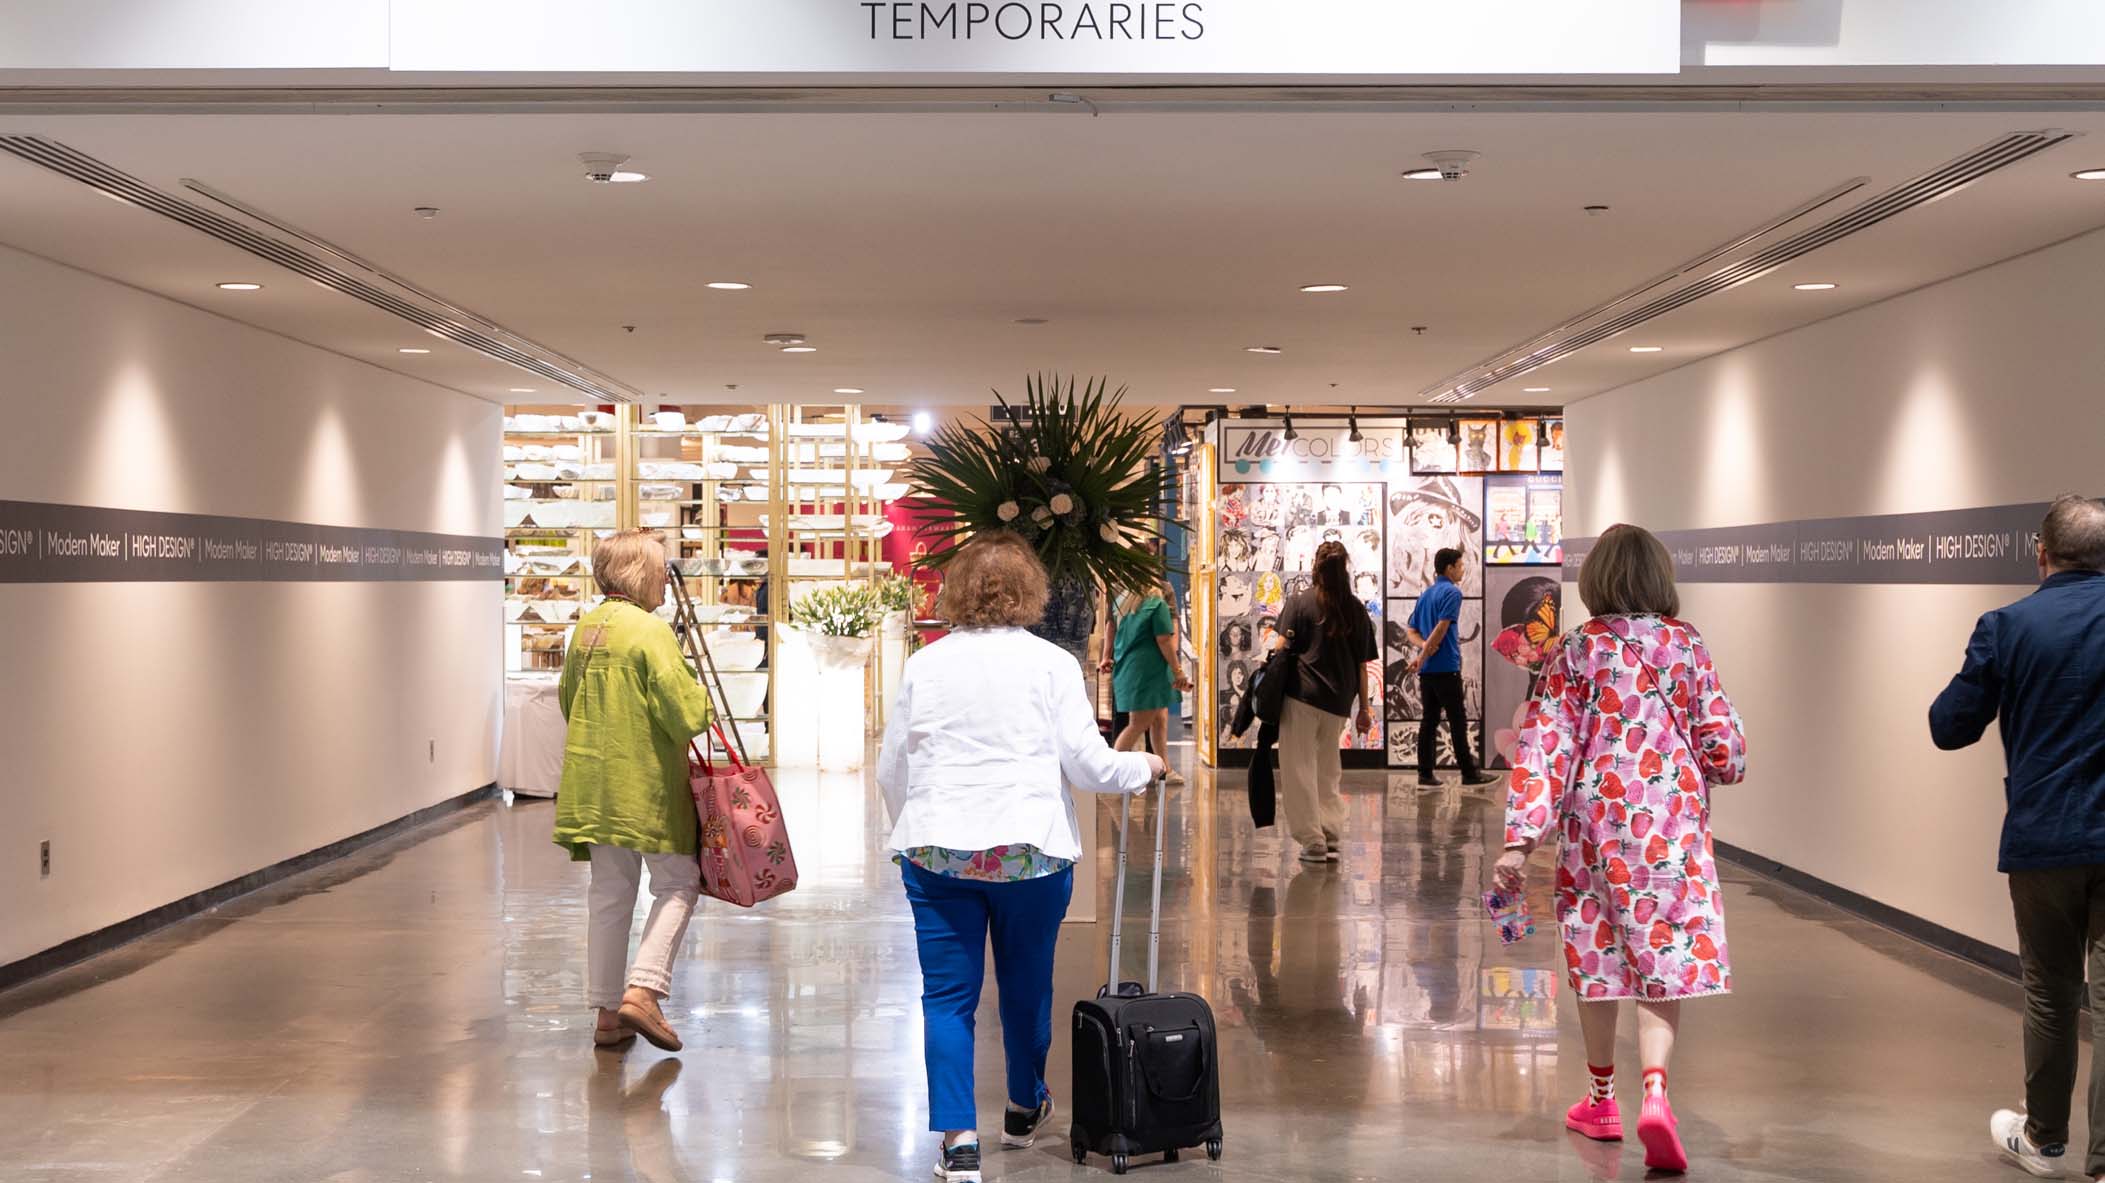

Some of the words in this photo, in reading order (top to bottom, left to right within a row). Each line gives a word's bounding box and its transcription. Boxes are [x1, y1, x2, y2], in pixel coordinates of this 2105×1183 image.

[860, 2, 1205, 40] TEMPORARIES
[48, 530, 88, 556] Modern
[89, 532, 121, 557] Maker
[132, 535, 157, 558] HIGH
[204, 537, 233, 559] Modern
[235, 539, 257, 560] Maker
[265, 542, 284, 560] HIGH
[319, 544, 342, 562] Modern
[1699, 547, 1714, 564] HIGH
[1746, 545, 1770, 563] Modern
[1770, 543, 1791, 562] Maker
[1800, 541, 1820, 561] HIGH
[1863, 539, 1895, 561] Modern
[1896, 537, 1924, 560] Maker
[1936, 535, 1963, 559] HIGH
